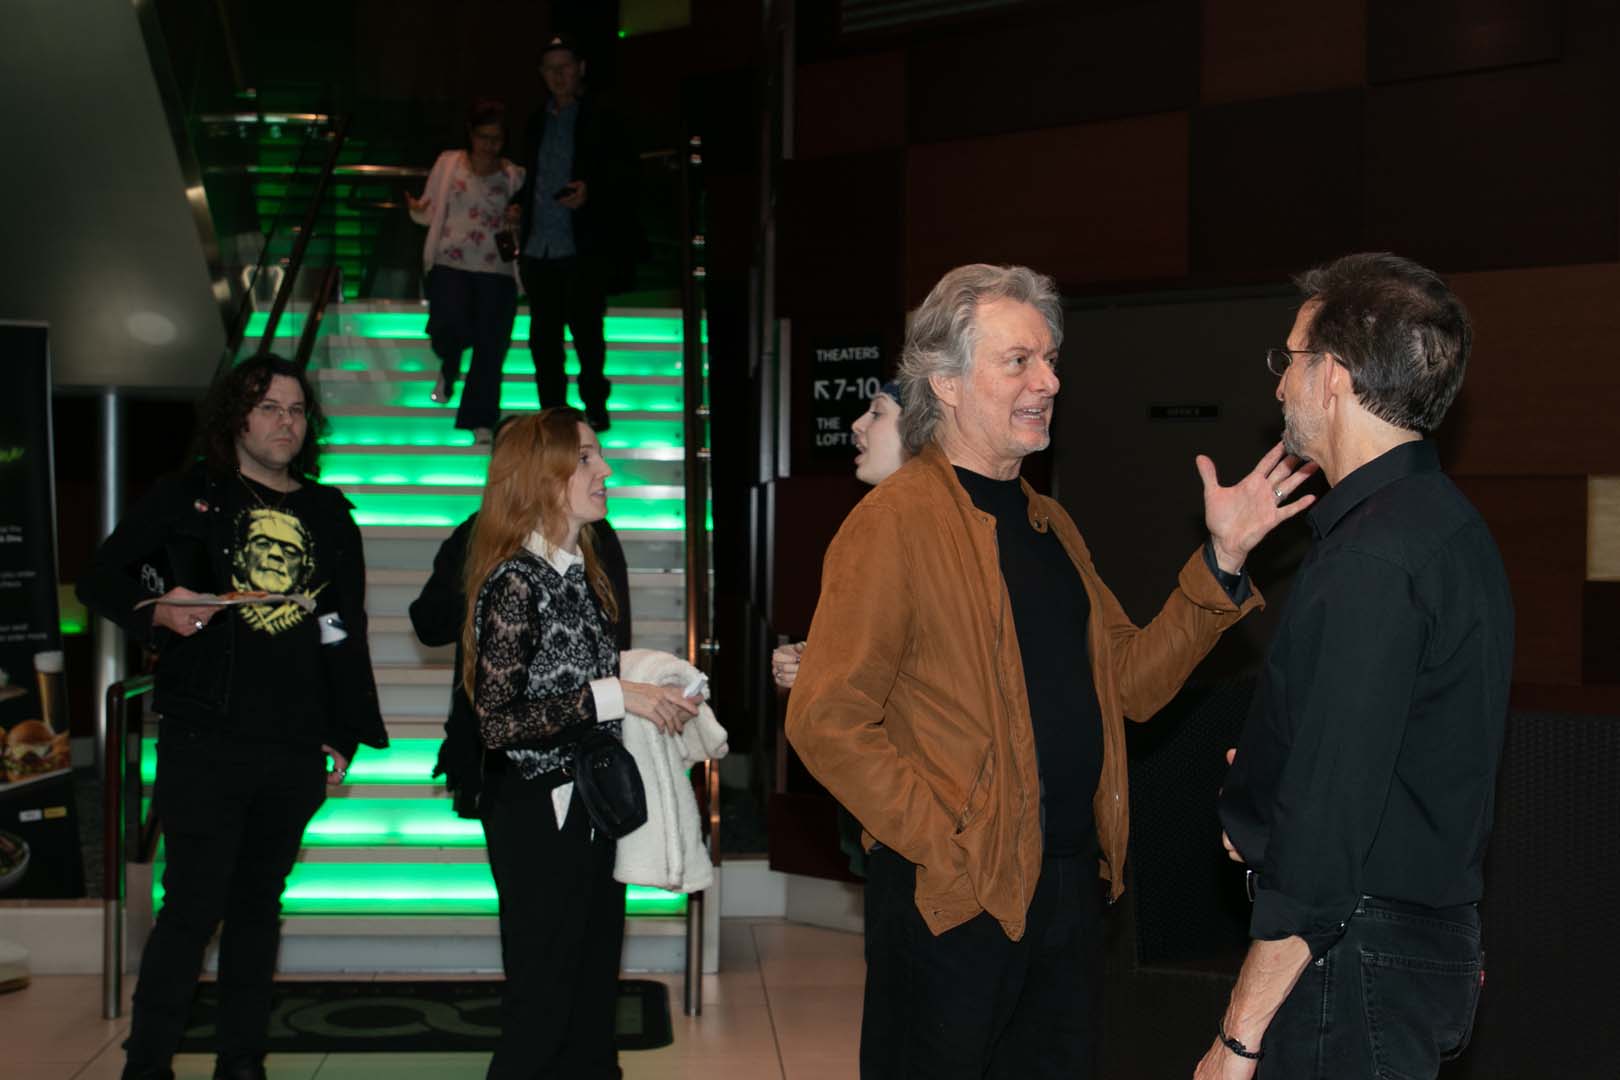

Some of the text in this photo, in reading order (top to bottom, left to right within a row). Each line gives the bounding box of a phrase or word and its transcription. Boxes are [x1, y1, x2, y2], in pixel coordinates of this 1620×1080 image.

[816, 346, 880, 363] THEATERS
[834, 376, 881, 401] 7-10
[816, 416, 841, 430] THE
[816, 432, 848, 447] LOFT
